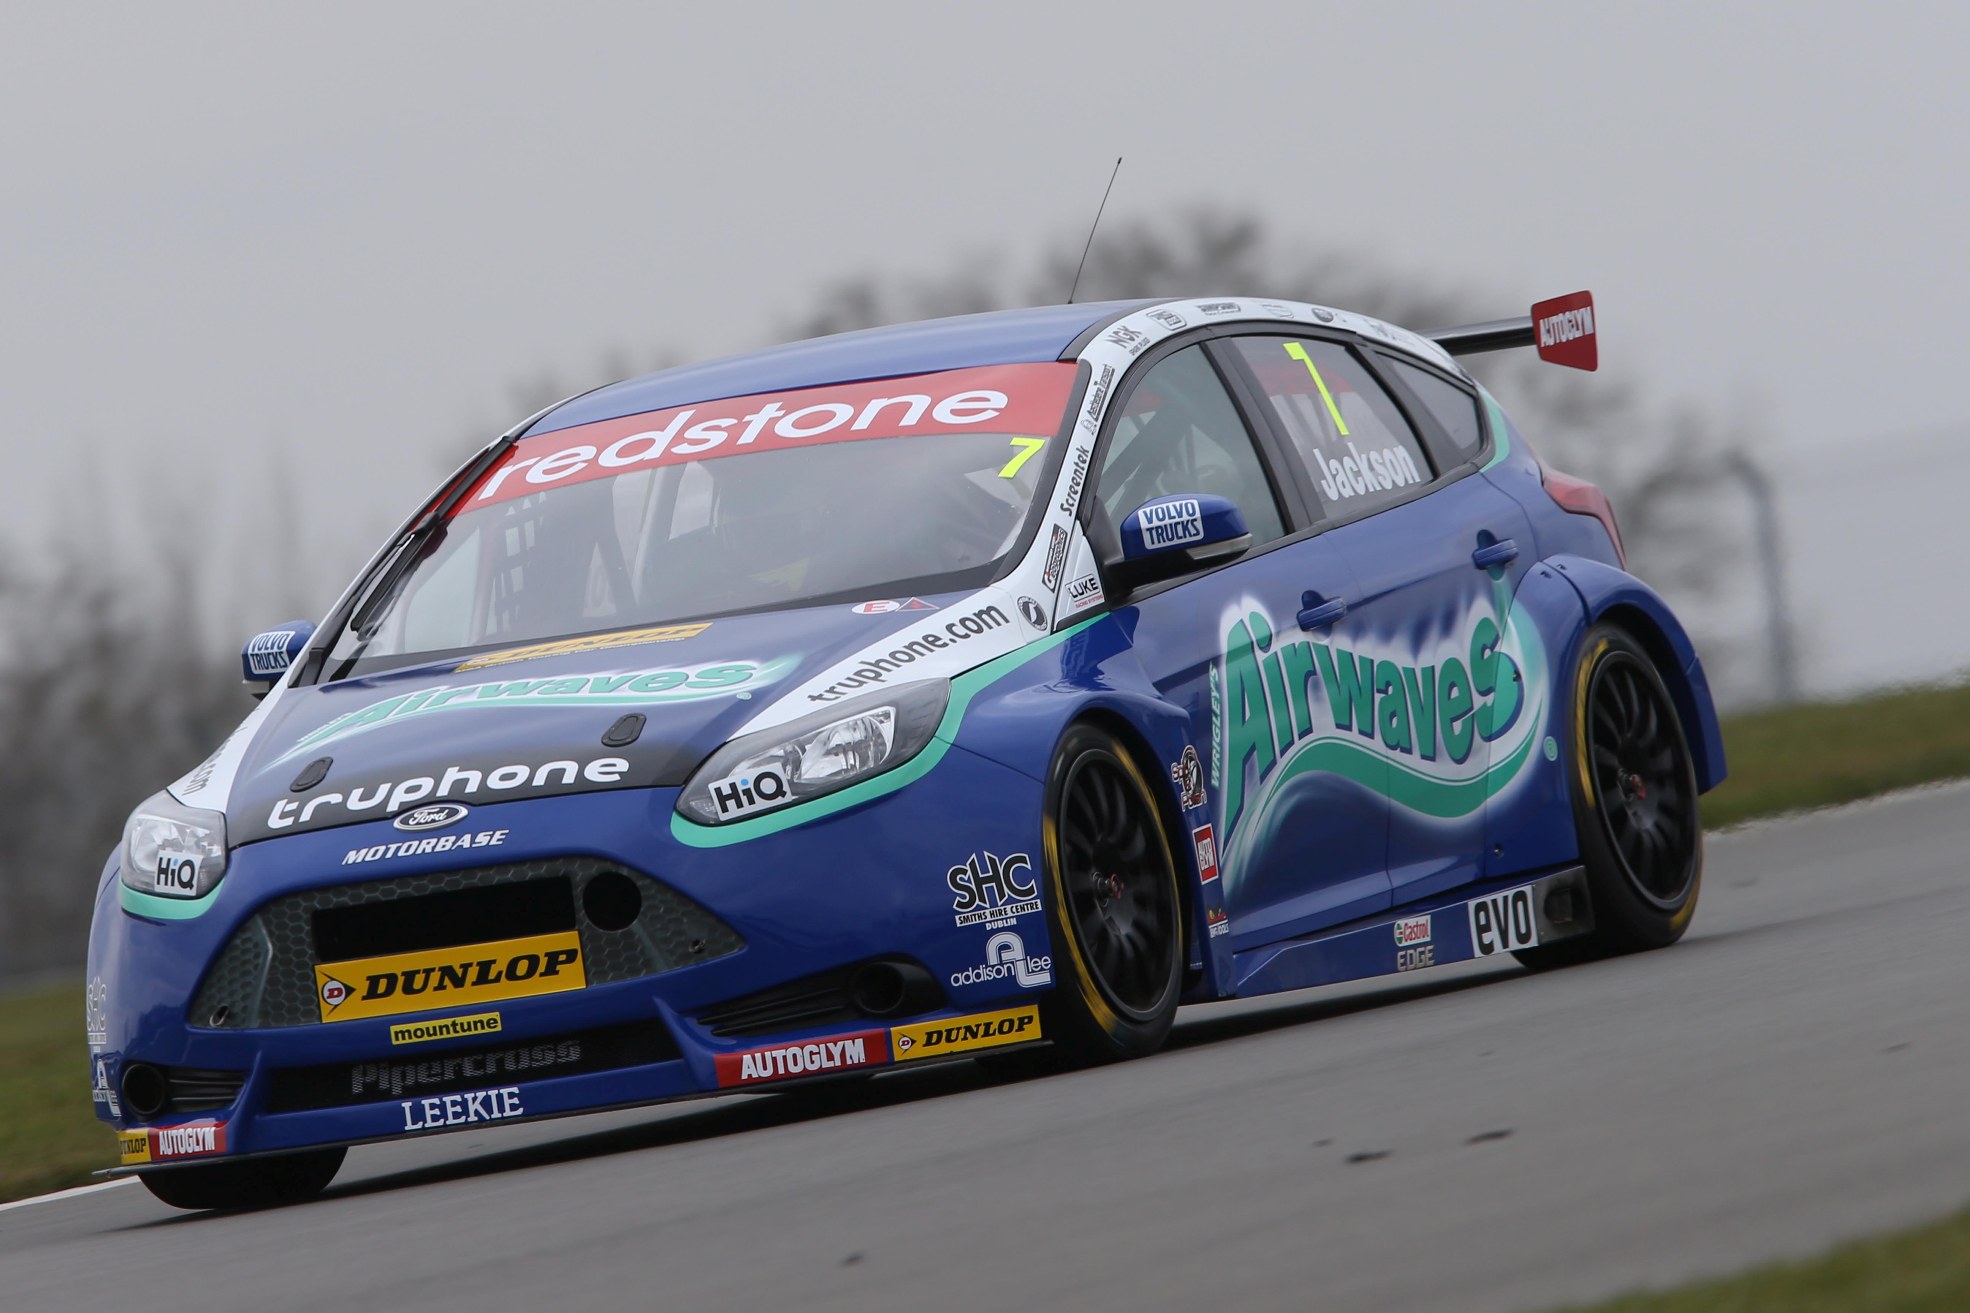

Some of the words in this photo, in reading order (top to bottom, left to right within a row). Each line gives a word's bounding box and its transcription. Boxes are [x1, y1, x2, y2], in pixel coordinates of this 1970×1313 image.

[1106, 325, 1143, 349] NGK
[478, 389, 1009, 501] redstone
[997, 437, 1045, 479] 7
[1059, 444, 1090, 518] Screentek
[1313, 441, 1422, 501] Jackson
[1142, 501, 1197, 525] VOLVO
[1146, 518, 1201, 546] TRUCKS
[1068, 578, 1099, 599] LUKE
[250, 650, 288, 671] TRUCKS
[251, 633, 291, 653] VOLVO
[807, 603, 1010, 703] truphone.com
[330, 662, 758, 733] Airwaves
[1209, 662, 1221, 789] WRIGLEY'S
[1222, 610, 1526, 853] Airwaves
[267, 757, 630, 829] truphone
[714, 772, 787, 814] HiQ
[408, 807, 449, 825] Ford
[341, 829, 510, 866] MOTORBASE
[156, 857, 196, 890] HiQ
[946, 850, 1038, 913] SHC
[957, 912, 988, 926] SMITHS
[989, 908, 1008, 919] HIRE
[1010, 900, 1041, 915] CENTRE
[985, 917, 1018, 931] DUBLIN
[1403, 918, 1429, 942] Castrol
[1474, 889, 1533, 956] evo
[361, 947, 579, 1001] DUNLOP
[950, 960, 1016, 987] addison
[1027, 955, 1052, 973] lee
[1397, 944, 1435, 972] EDGE
[393, 1017, 499, 1042] mountune
[922, 1014, 1034, 1048] DUNLOP
[351, 1040, 581, 1096] Pipercross
[740, 1038, 866, 1080] AUTOGLYM
[401, 1086, 524, 1131] LEEKIE
[159, 1126, 216, 1156] AUTOGLYM
